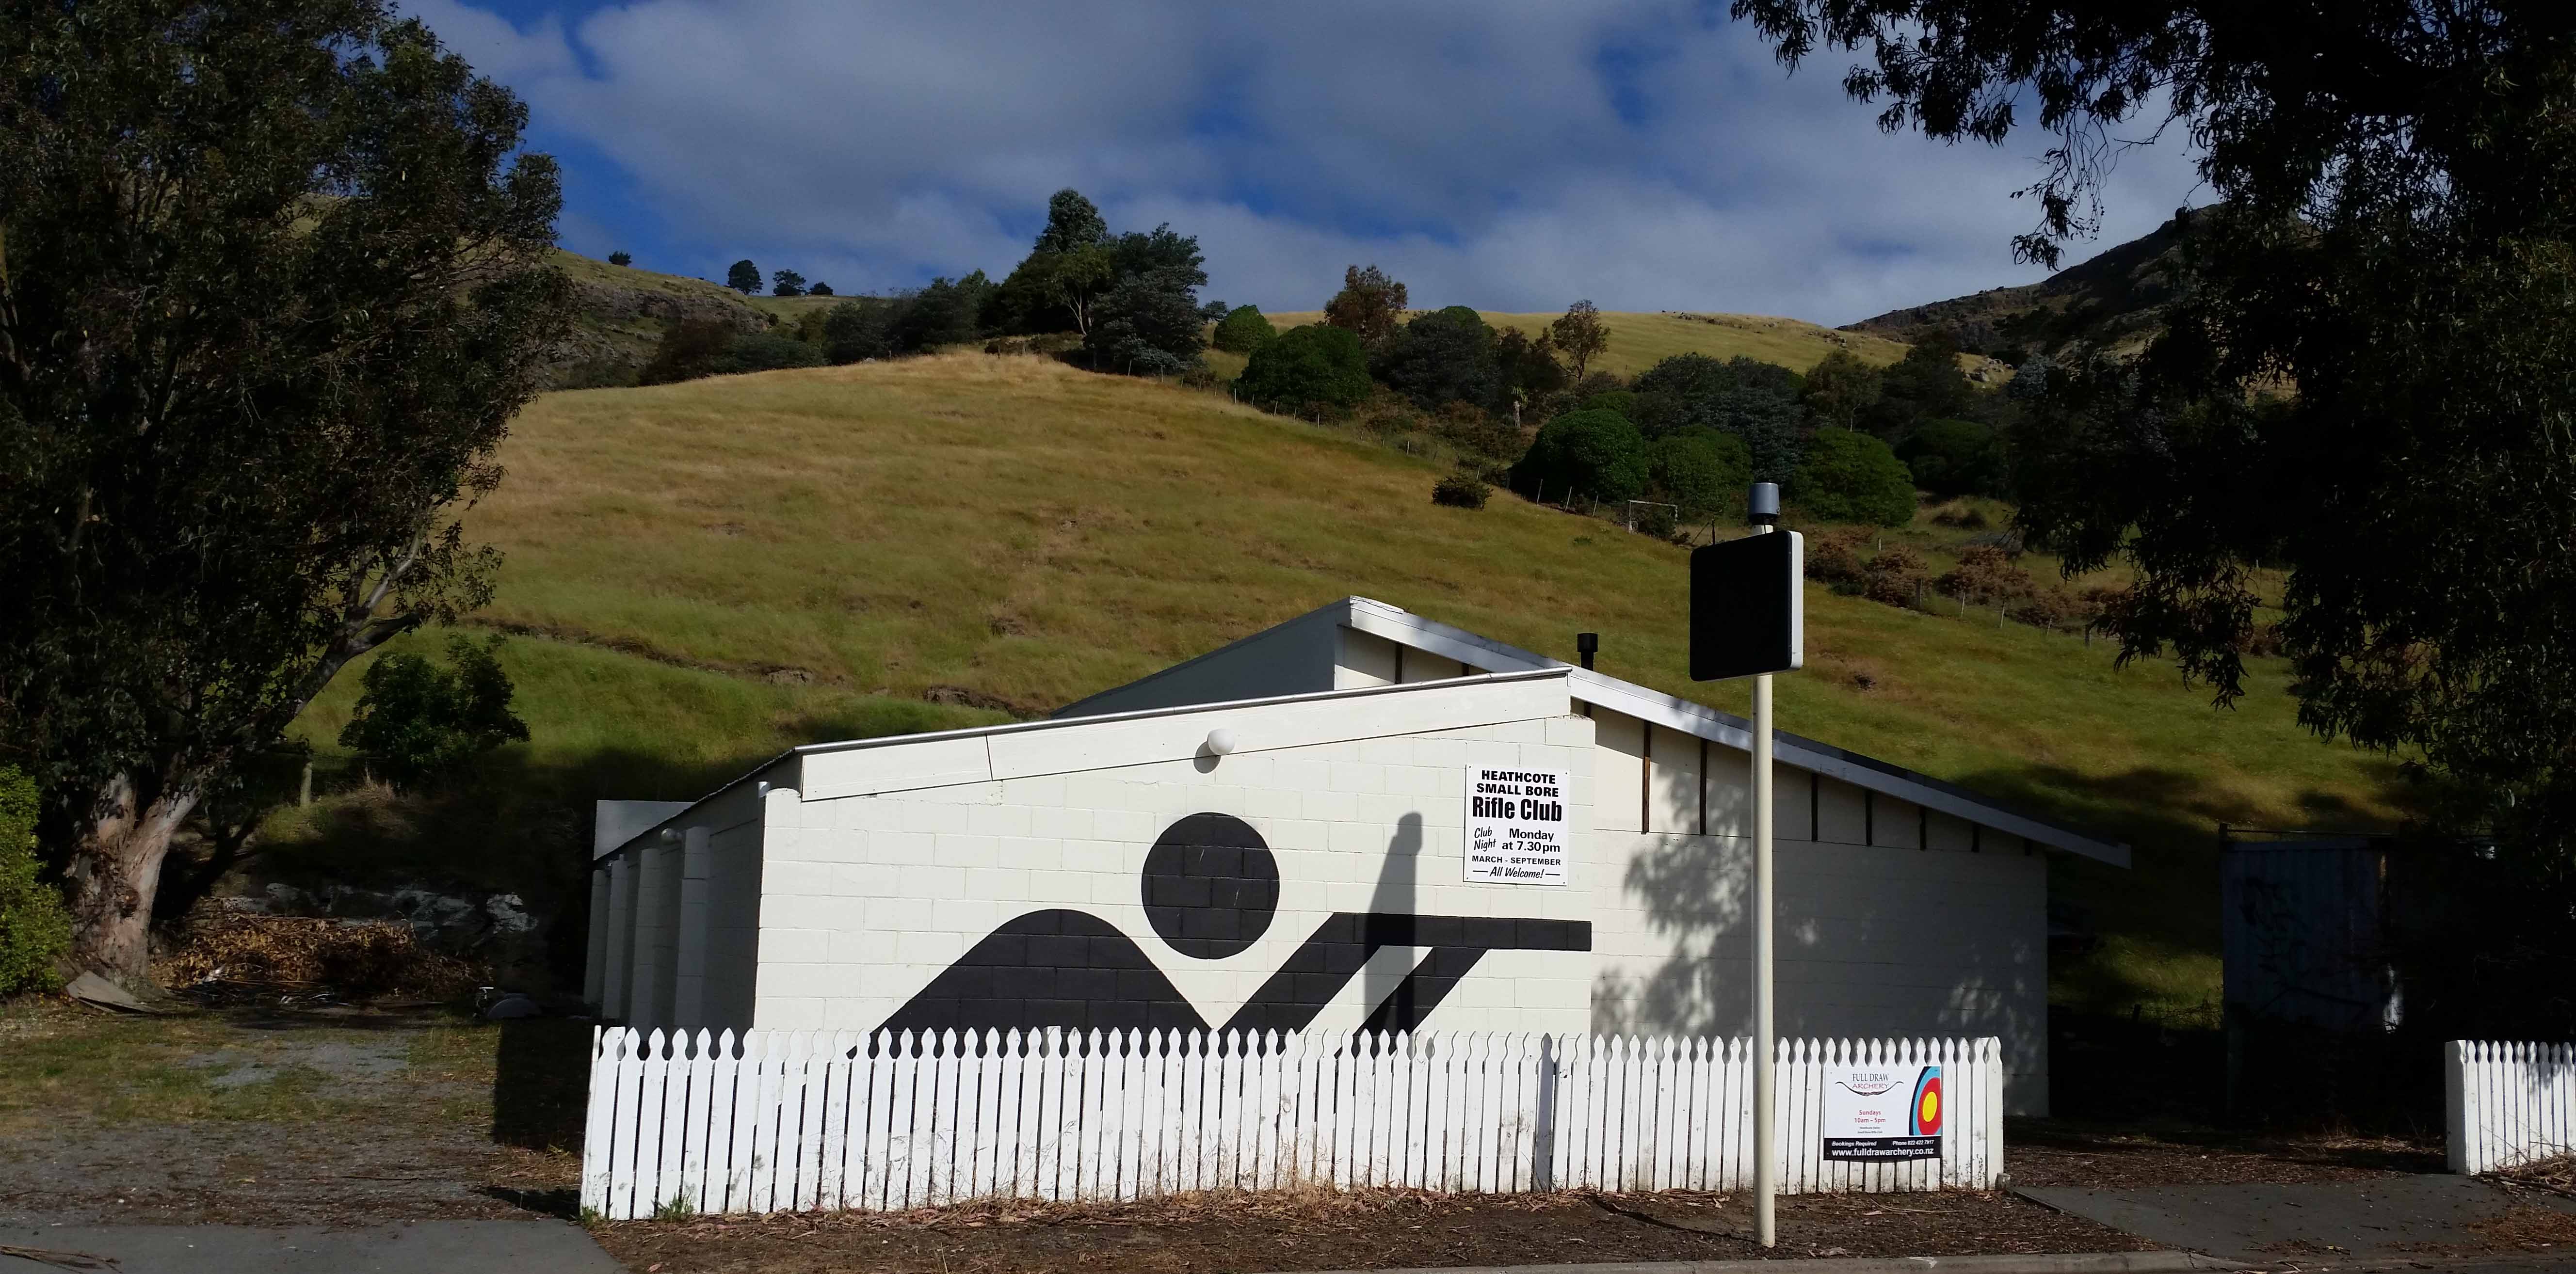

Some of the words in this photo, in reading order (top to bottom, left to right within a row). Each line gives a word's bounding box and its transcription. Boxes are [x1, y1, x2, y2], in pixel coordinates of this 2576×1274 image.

[1481, 770, 1556, 784] HEATHCOTE
[1476, 783, 1521, 795] SMALL
[1525, 786, 1559, 797] BORE
[1472, 796, 1515, 819] Rifle
[1520, 798, 1562, 822] Club
[1474, 826, 1493, 839] Club
[1509, 828, 1554, 843] Monday
[1474, 838, 1497, 852] Night
[1502, 841, 1513, 850] at
[1472, 855, 1503, 863] MARCH
[1510, 857, 1561, 866] SEPTEMBER
[1489, 866, 1503, 877] All
[1505, 867, 1545, 878] Welcome!
[1852, 1073, 1868, 1082] FULL
[1869, 1073, 1889, 1082] DRAW
[1832, 1147, 1934, 1157] www.fulldrawarchery.co.nz
